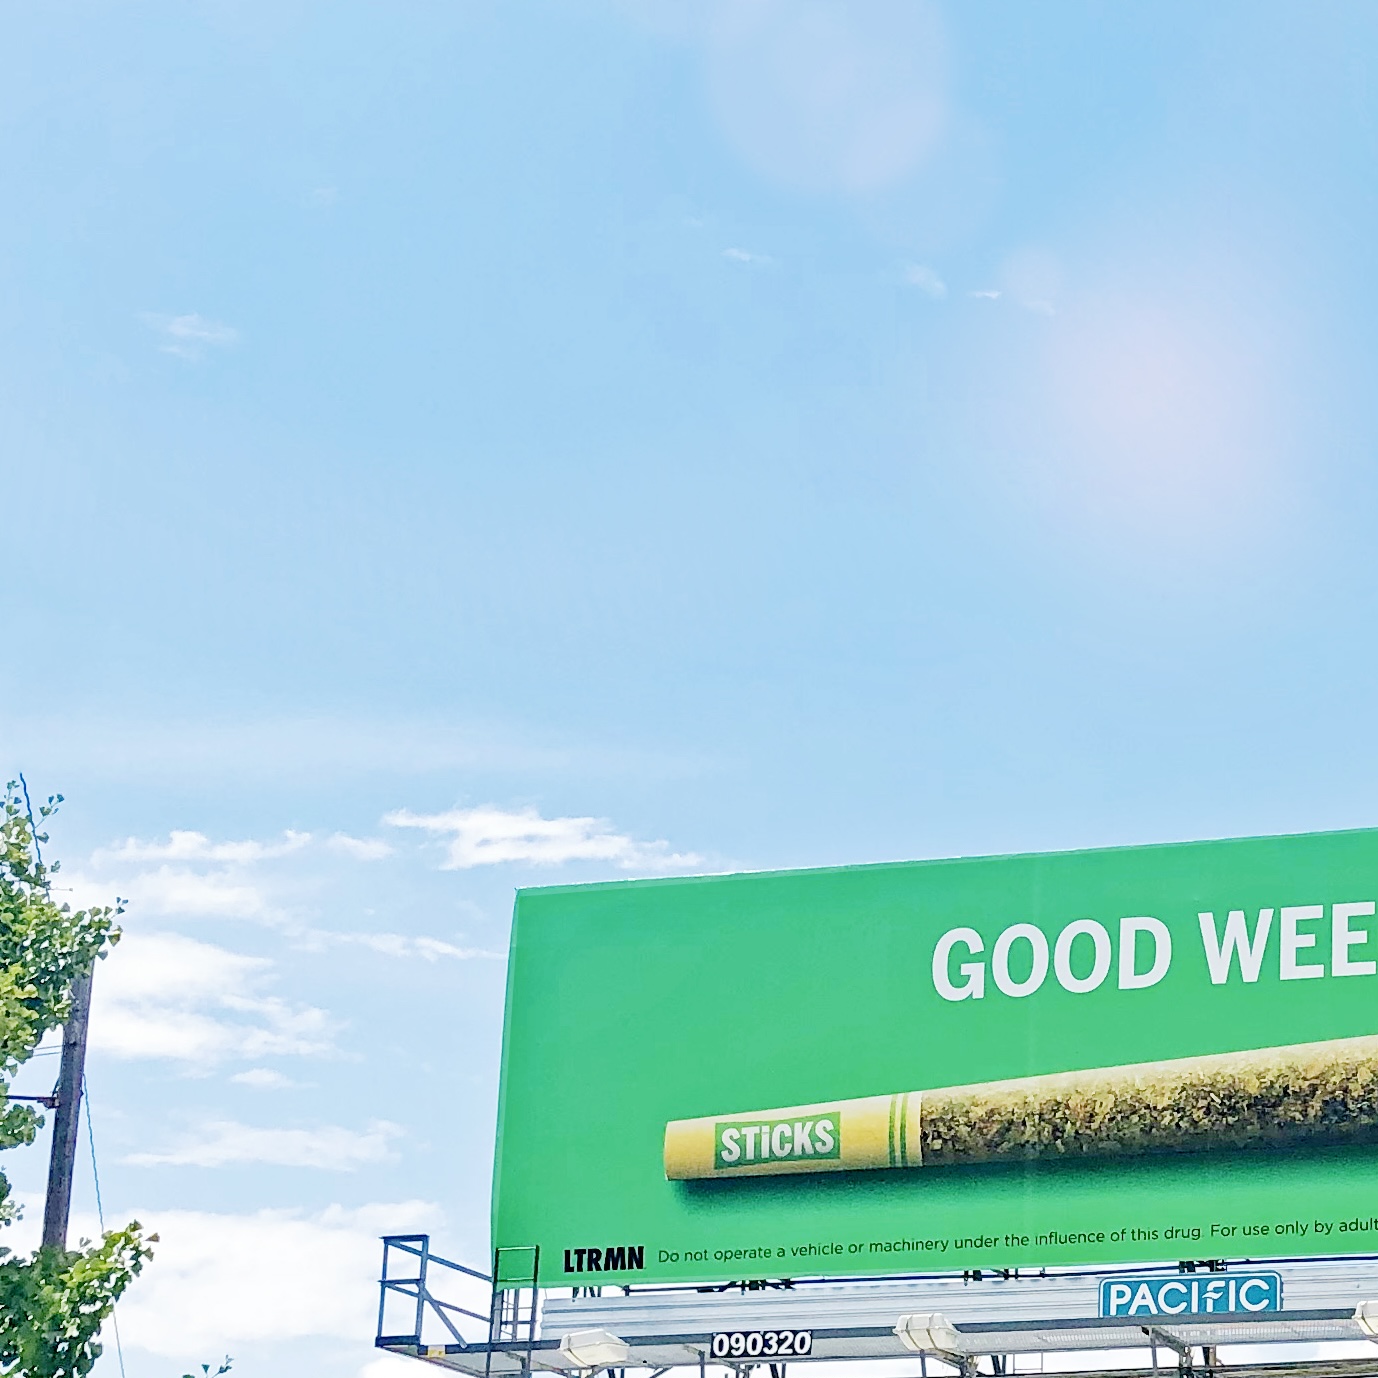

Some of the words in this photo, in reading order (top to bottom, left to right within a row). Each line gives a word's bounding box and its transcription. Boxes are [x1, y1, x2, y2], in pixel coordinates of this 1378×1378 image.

[932, 916, 1172, 1002] GOOD
[564, 1245, 644, 1273] LTRMN
[658, 1249, 680, 1263] Do
[684, 1249, 709, 1262] not
[713, 1246, 772, 1263] operate
[776, 1247, 786, 1258] a
[790, 1242, 844, 1257] vehicle
[847, 1243, 865, 1254] or
[869, 1238, 950, 1253] machinery
[954, 1234, 1000, 1250] under
[1004, 1233, 1030, 1248] the
[1035, 1231, 1106, 1246] influence
[1110, 1227, 1127, 1242] of
[1130, 1228, 1159, 1242] this
[1210, 1223, 1238, 1237] For
[1242, 1225, 1270, 1236] use
[1274, 1220, 1309, 1237] only
[1314, 1219, 1334, 1236] by
[1109, 1278, 1270, 1316] PACIFIC
[712, 1331, 812, 1357] 090320
